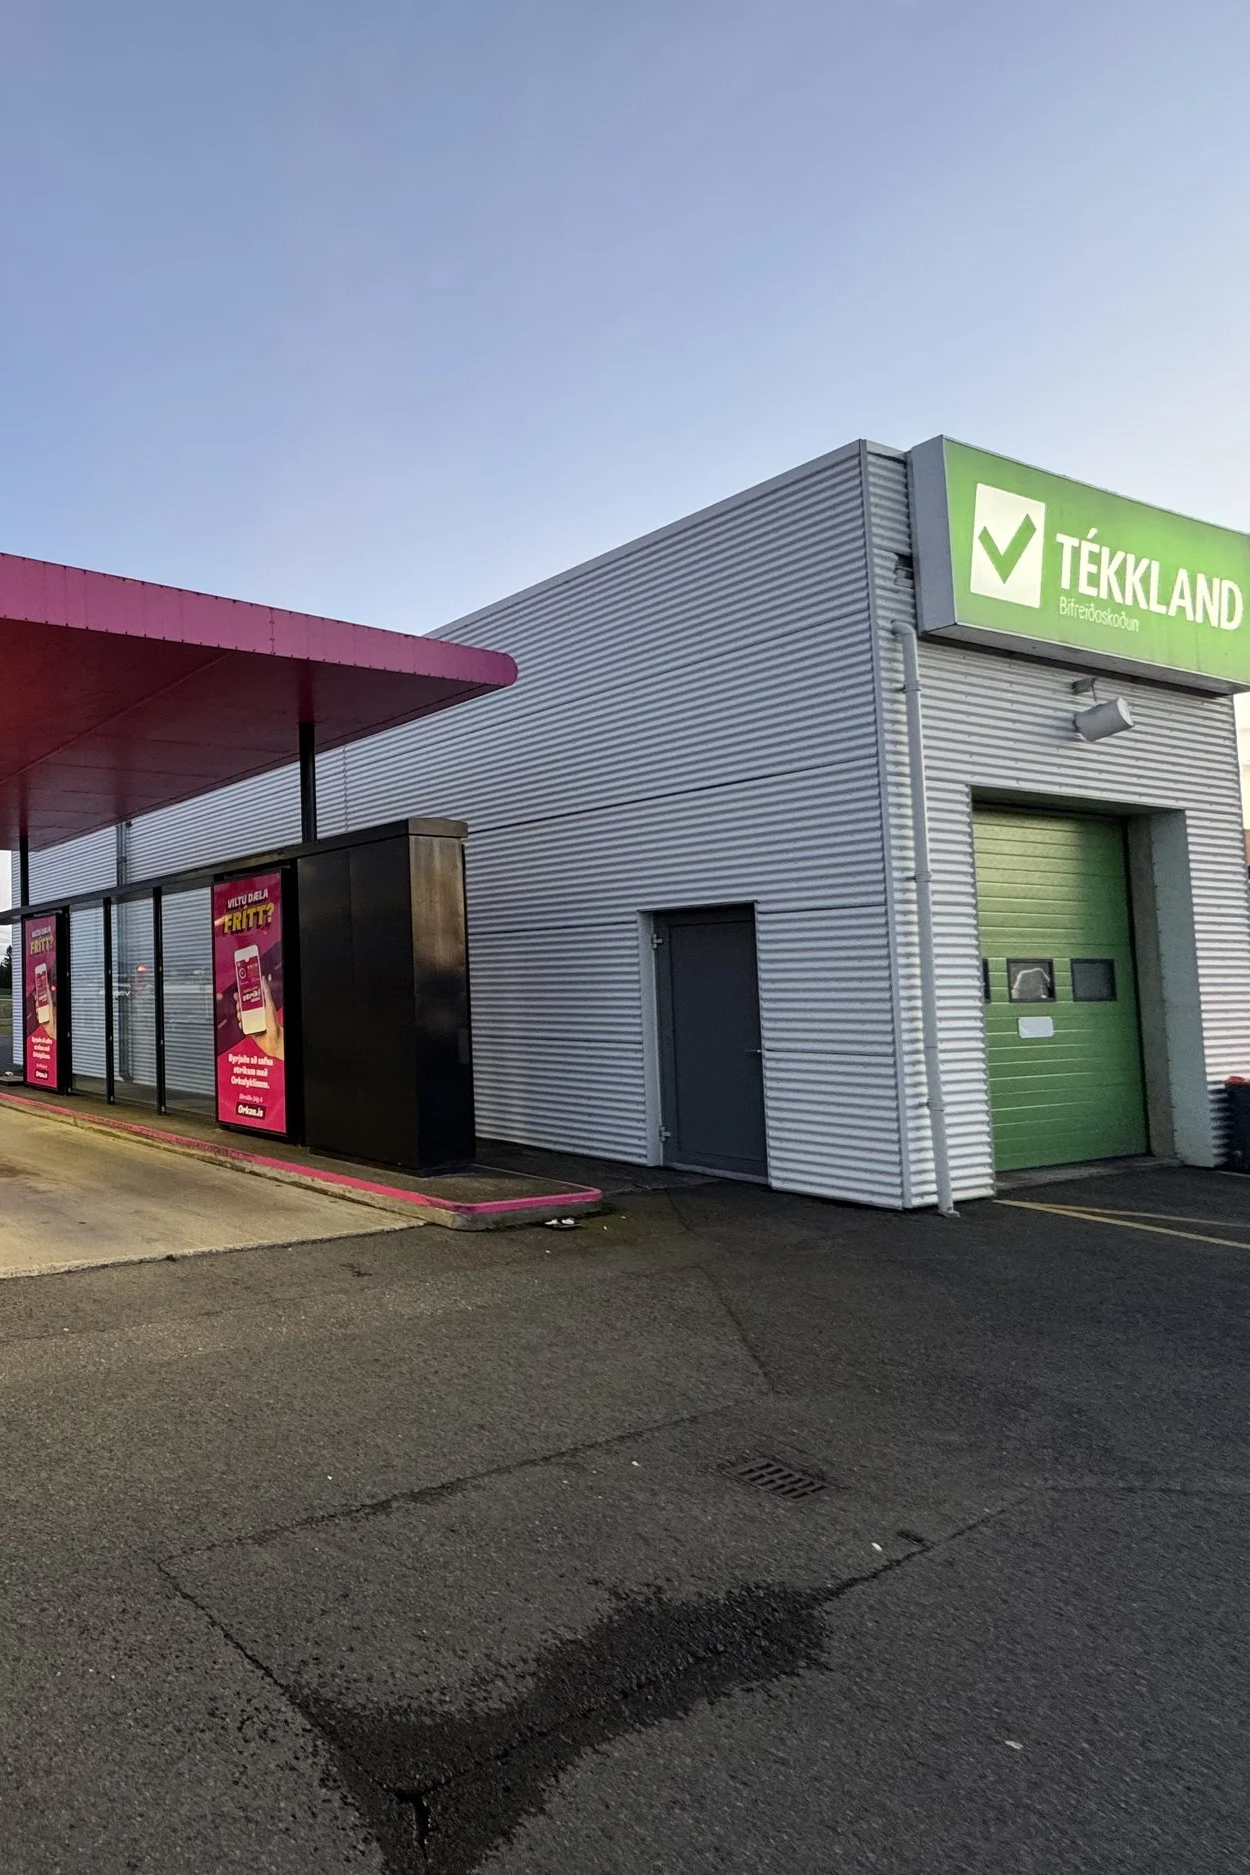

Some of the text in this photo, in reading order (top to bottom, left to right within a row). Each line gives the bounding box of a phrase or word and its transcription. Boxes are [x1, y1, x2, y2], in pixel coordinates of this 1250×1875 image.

[1056, 528, 1244, 631] TÉKKLAND
[227, 888, 269, 909] VILTU DÆLA
[223, 902, 275, 934] FRÍTT?
[237, 1104, 264, 1117] Orkan.is
